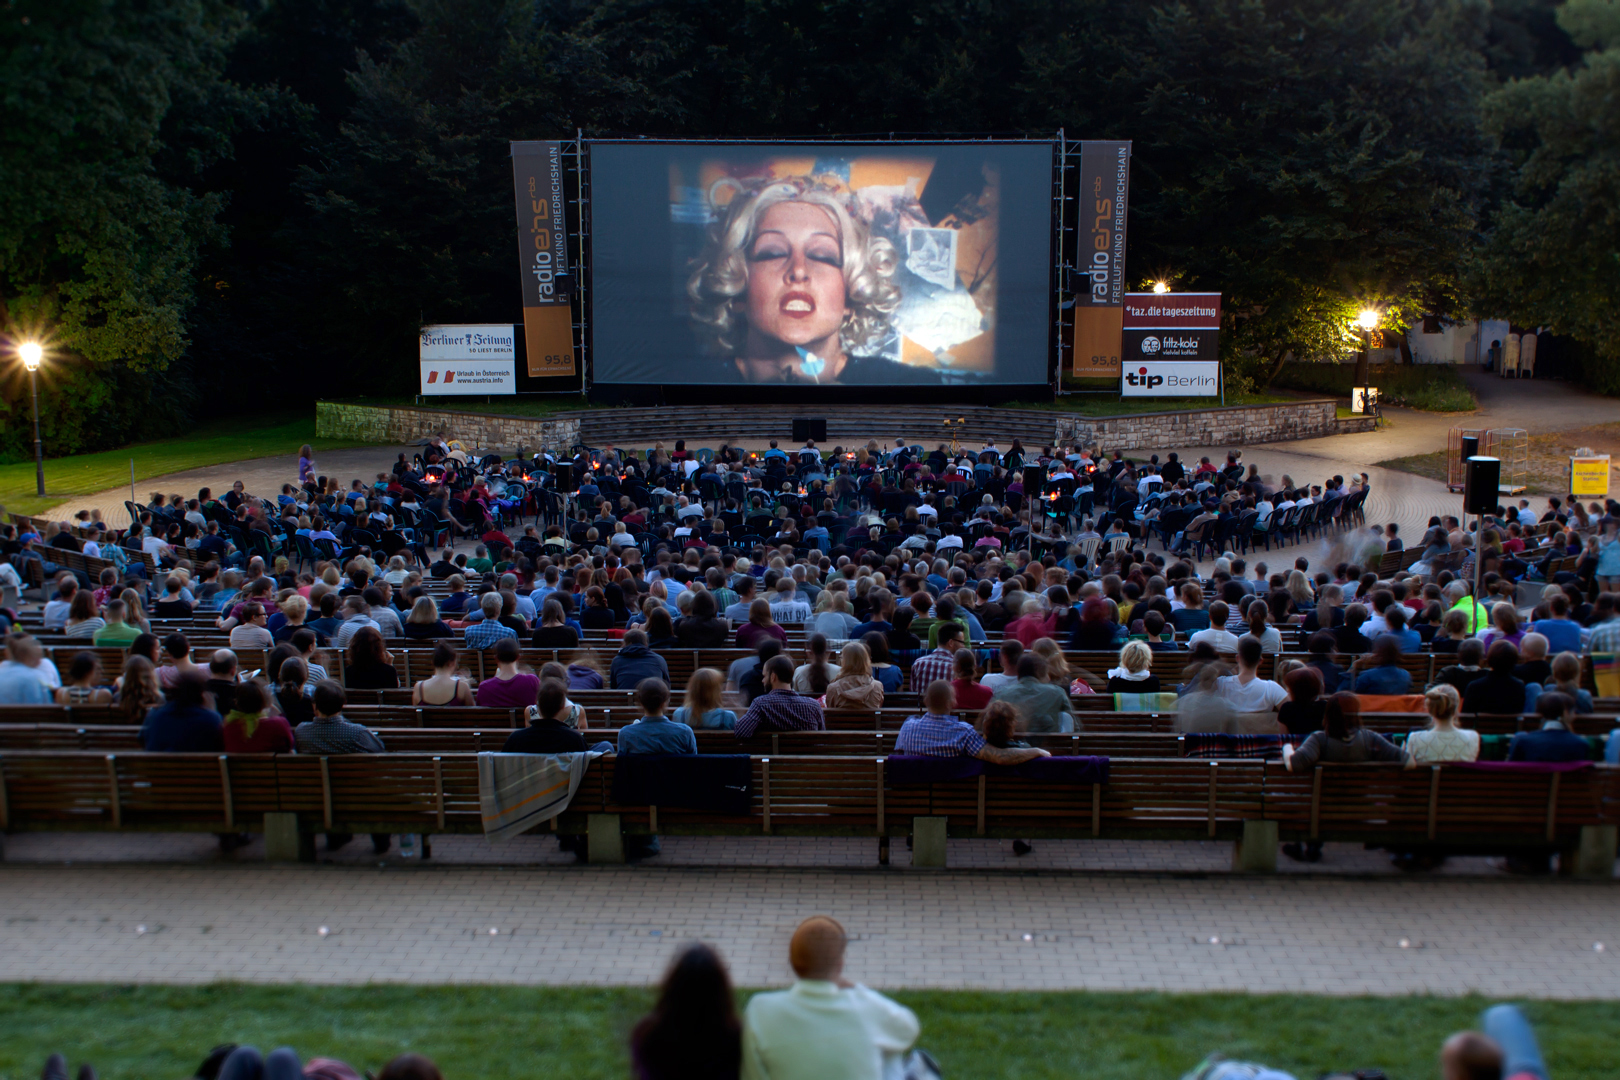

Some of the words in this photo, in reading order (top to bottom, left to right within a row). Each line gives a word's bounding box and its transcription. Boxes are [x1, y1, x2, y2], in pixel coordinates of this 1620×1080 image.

[550, 147, 563, 230] FRIEDRICHSHAIN
[1094, 176, 1102, 198] rbb
[1115, 147, 1126, 230] FRIEDRICHSHAIN
[1112, 234, 1123, 304] FREILUFTKINO
[1162, 306, 1216, 318] tageszeitung
[422, 334, 464, 346] Berliner
[474, 334, 512, 346] Zeitung
[1162, 336, 1198, 348] fritz-kola
[544, 354, 572, 366] 95,8
[1092, 356, 1118, 367] 95,8
[1126, 367, 1164, 389] tip
[1168, 376, 1216, 386] Berlin
